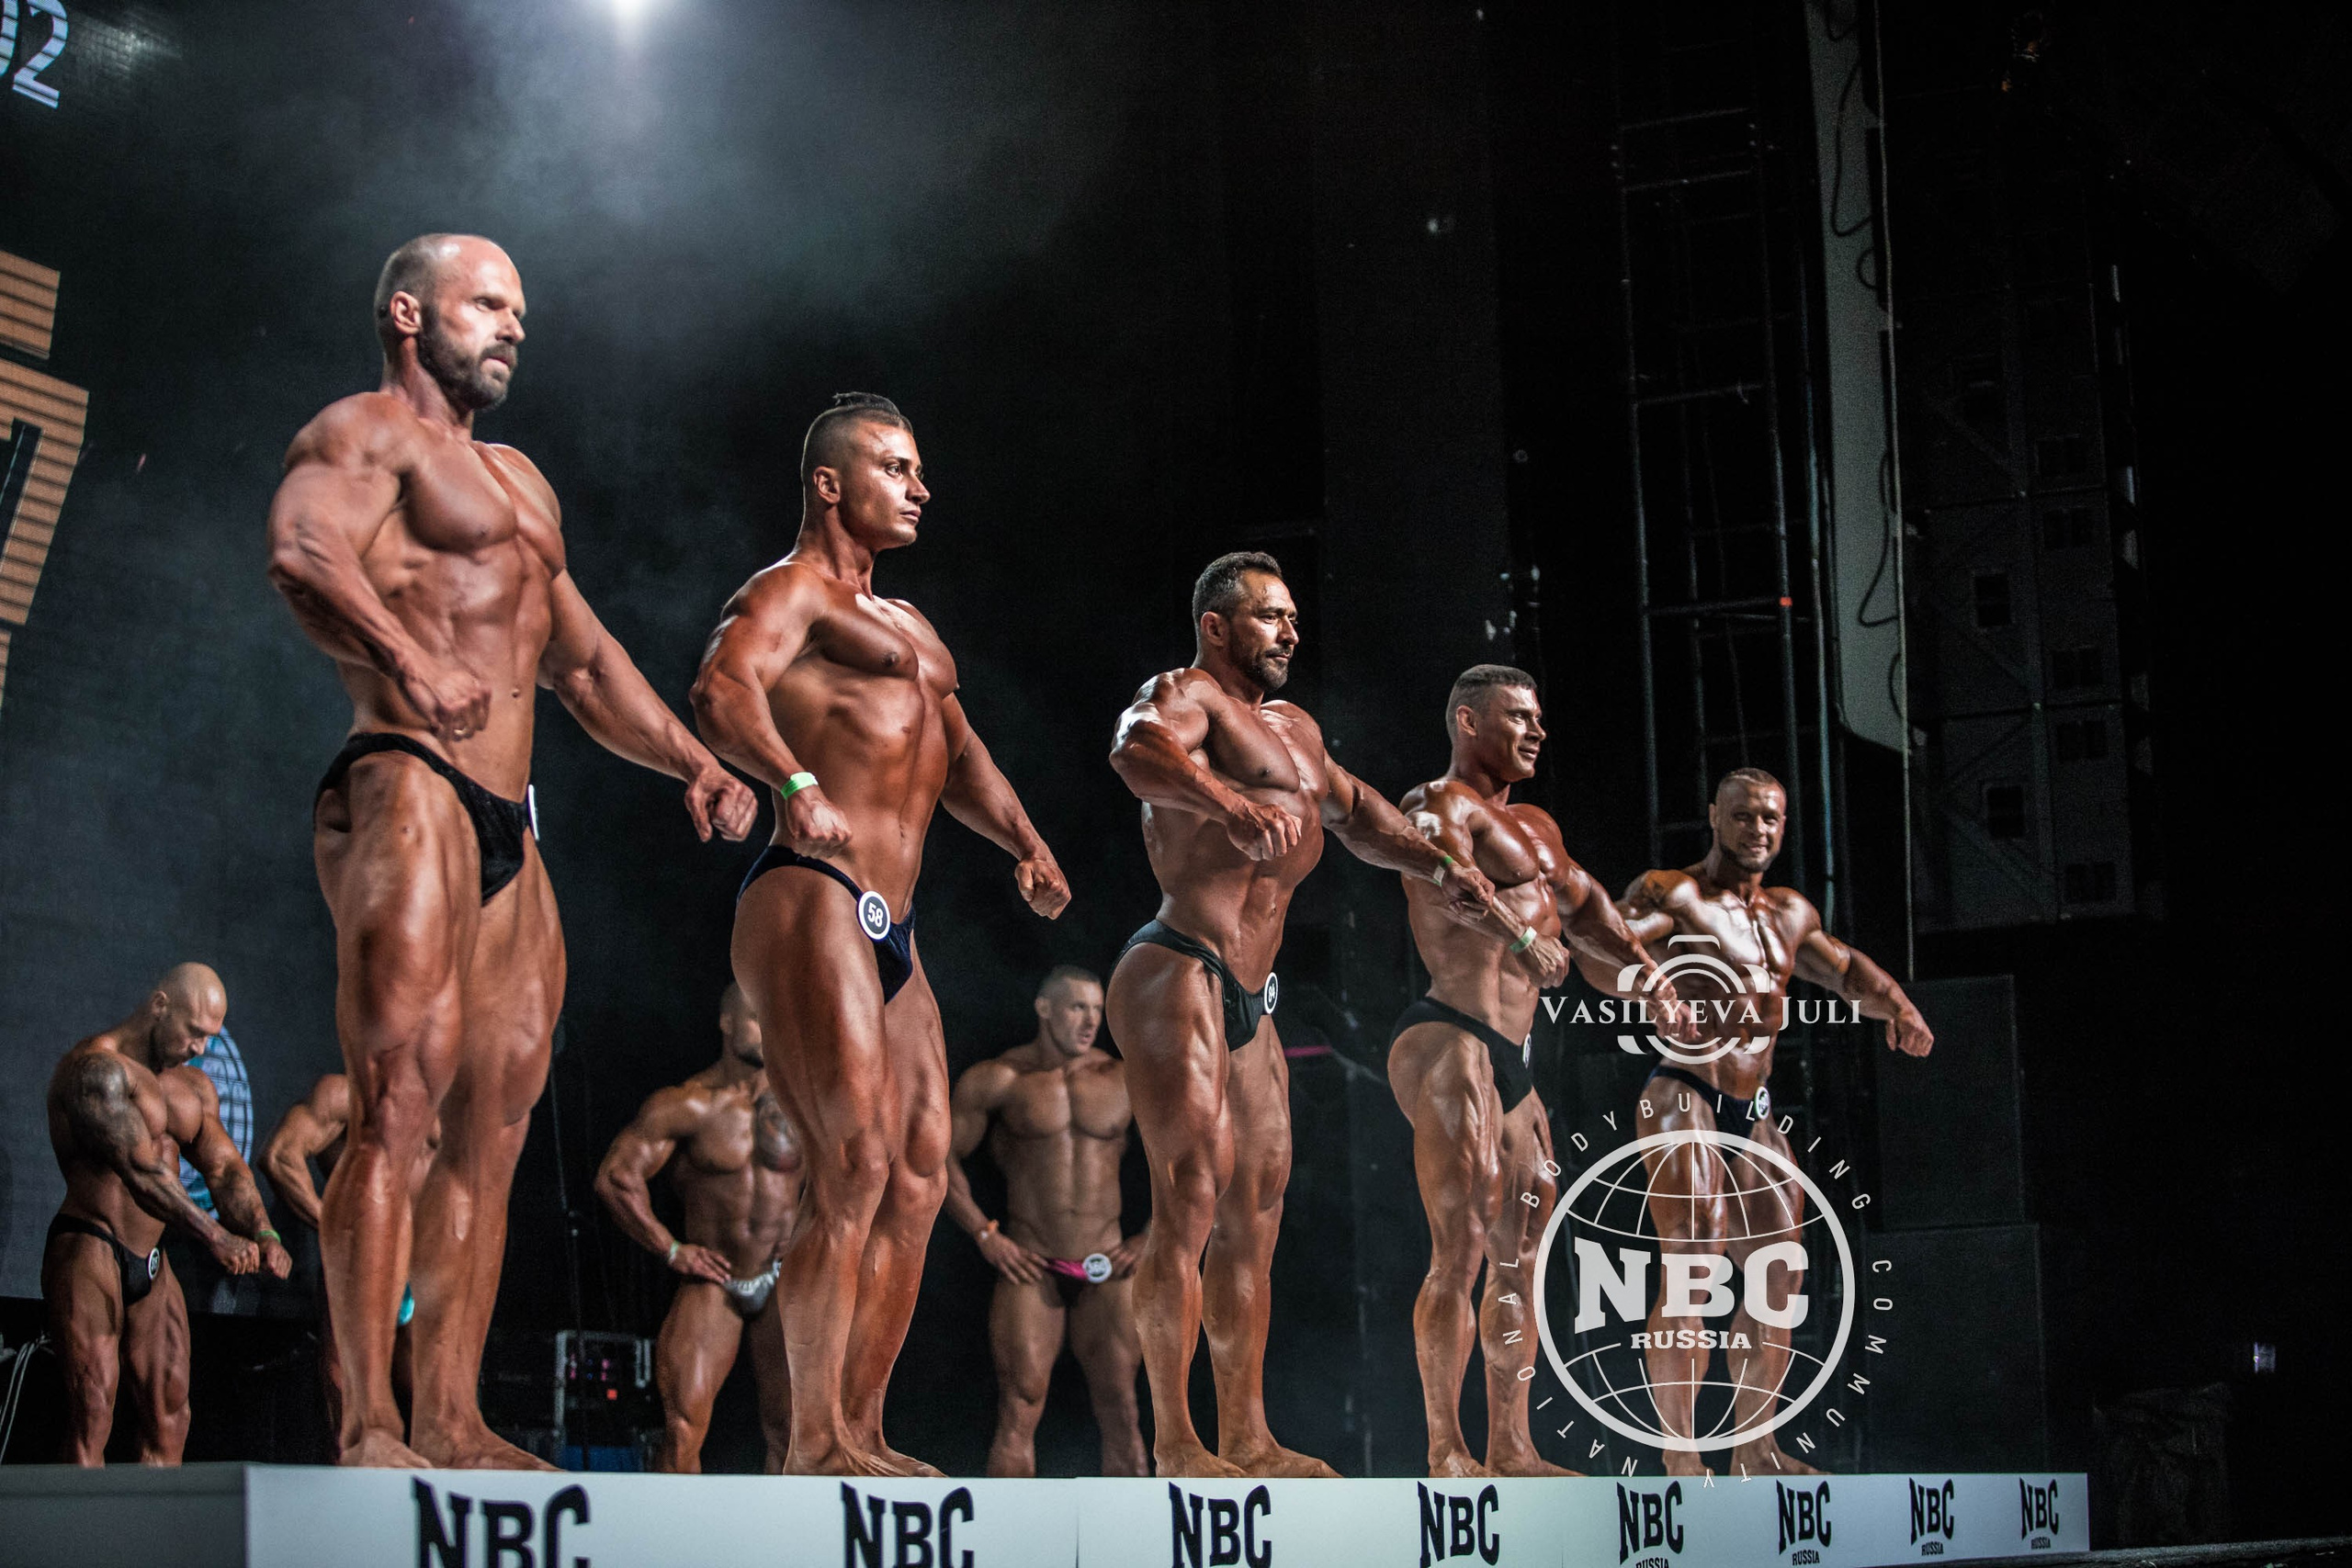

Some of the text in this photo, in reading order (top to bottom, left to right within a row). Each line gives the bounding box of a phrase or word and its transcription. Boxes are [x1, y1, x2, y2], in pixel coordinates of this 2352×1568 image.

[867, 902, 884, 927] 58
[411, 1475, 592, 1568] NBC
[840, 1481, 975, 1568] NBC
[1168, 1481, 1272, 1568] NBC
[1417, 1480, 1500, 1568] NBC
[1616, 1480, 1684, 1565] NBC
[1775, 1479, 1832, 1555] NBC
[1908, 1477, 1955, 1546] NBC
[2018, 1477, 2060, 1541] NBC
[2030, 1536, 2052, 1550] RUSSIA
[1792, 1549, 1821, 1566] RUSSIA
[1921, 1540, 1944, 1556] RUSSIA
